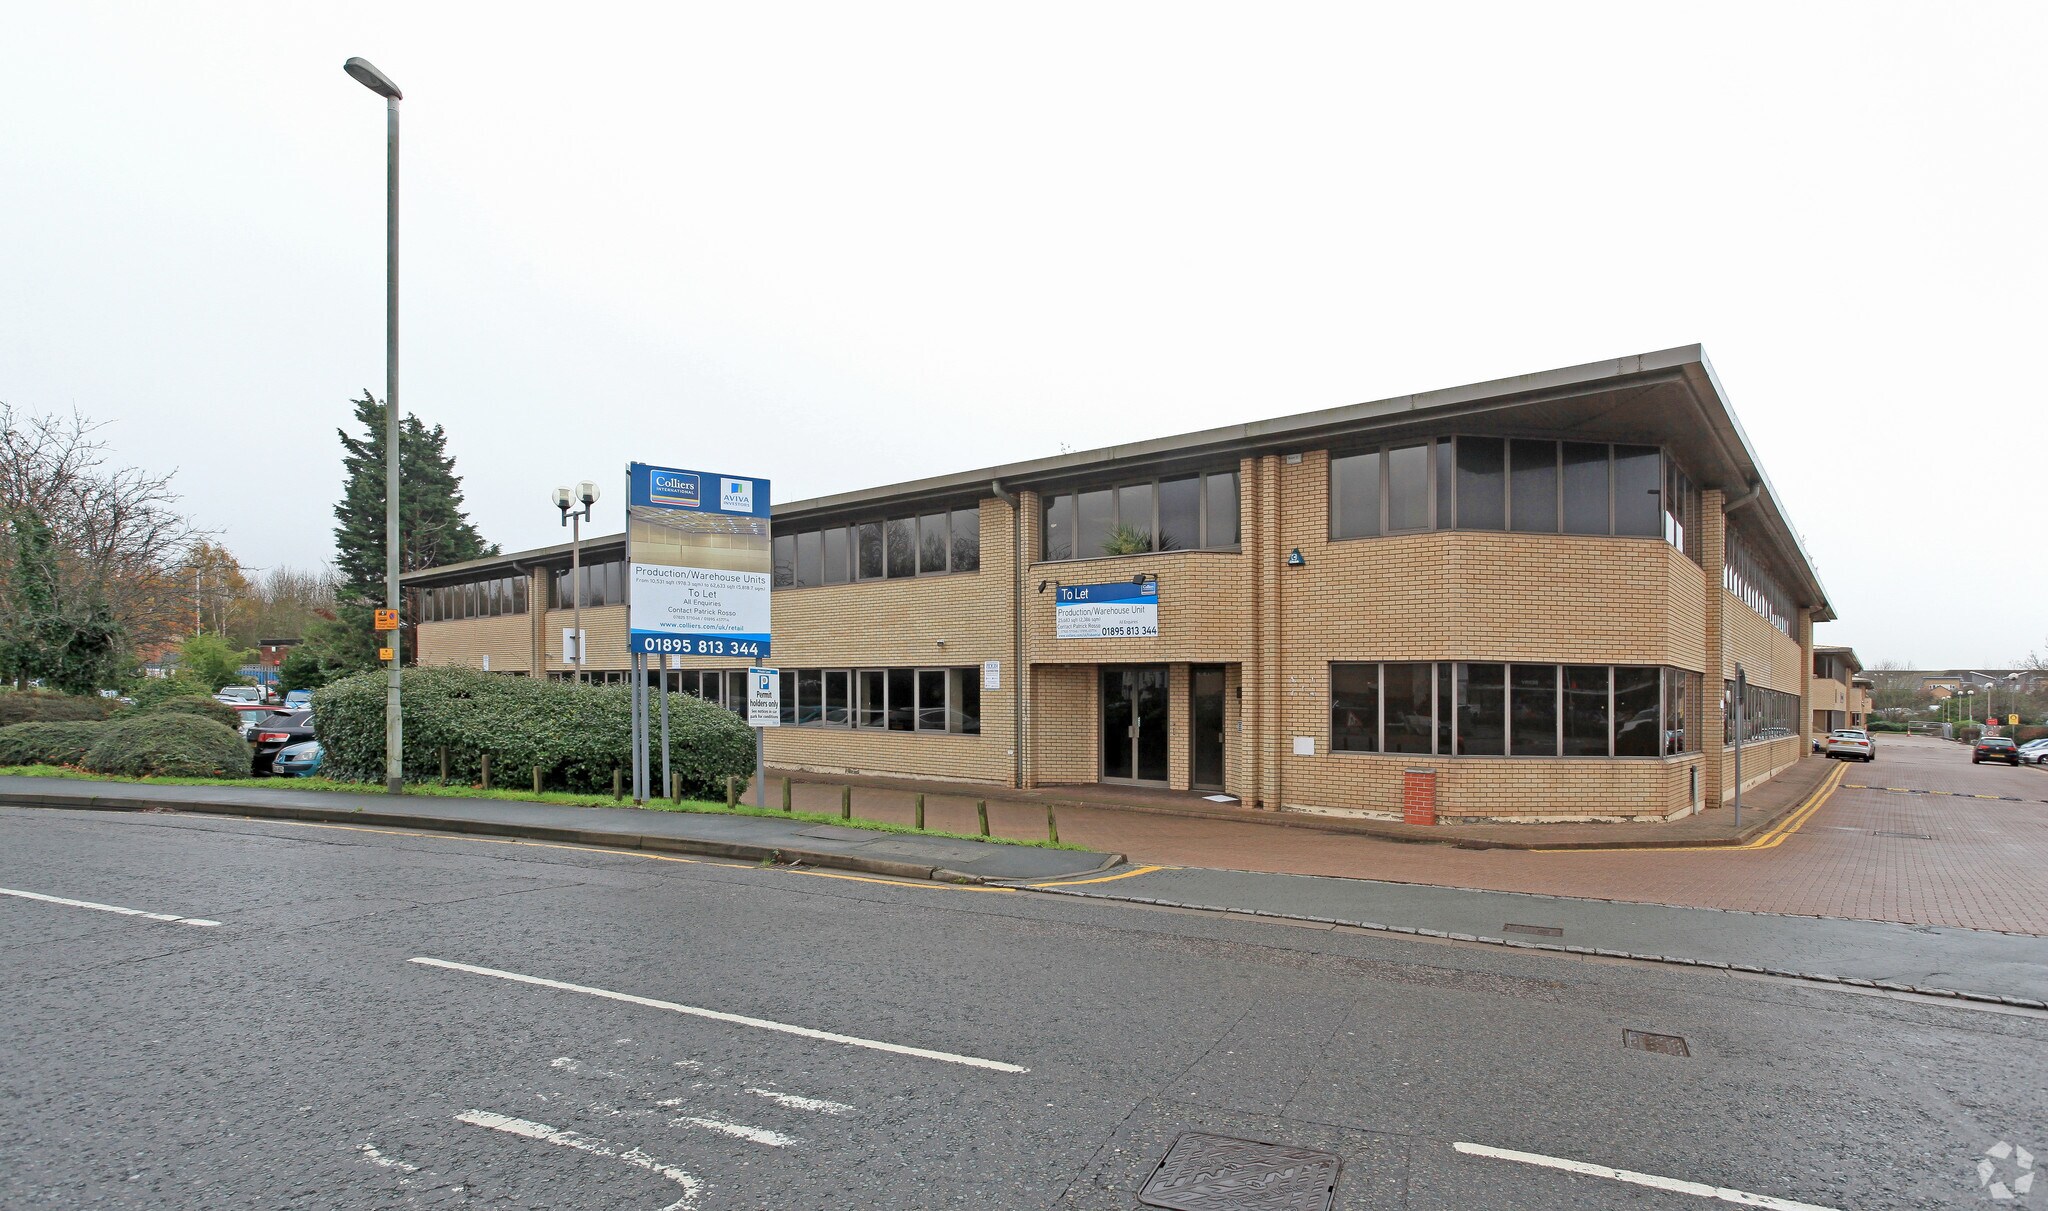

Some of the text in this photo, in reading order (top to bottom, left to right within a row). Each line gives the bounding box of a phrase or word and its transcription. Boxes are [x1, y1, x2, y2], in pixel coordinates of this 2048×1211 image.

[656, 476, 695, 490] Colliers
[656, 487, 694, 495] INTERNATIONAL
[724, 494, 750, 502] AVIVA
[636, 566, 766, 584] Production/Warehouse Units
[688, 588, 716, 598] To Let
[1062, 588, 1088, 600] To Let
[694, 599, 721, 607] Enquiries
[1058, 605, 1145, 617] Production/Warehouse Unit
[660, 621, 744, 631] www.colliers.com/uk/retail
[1102, 627, 1124, 636] 01895
[1126, 626, 1139, 635] 813
[1142, 626, 1156, 635] 344
[644, 638, 758, 655] 01895 813 344
[750, 699, 778, 709] holders only
